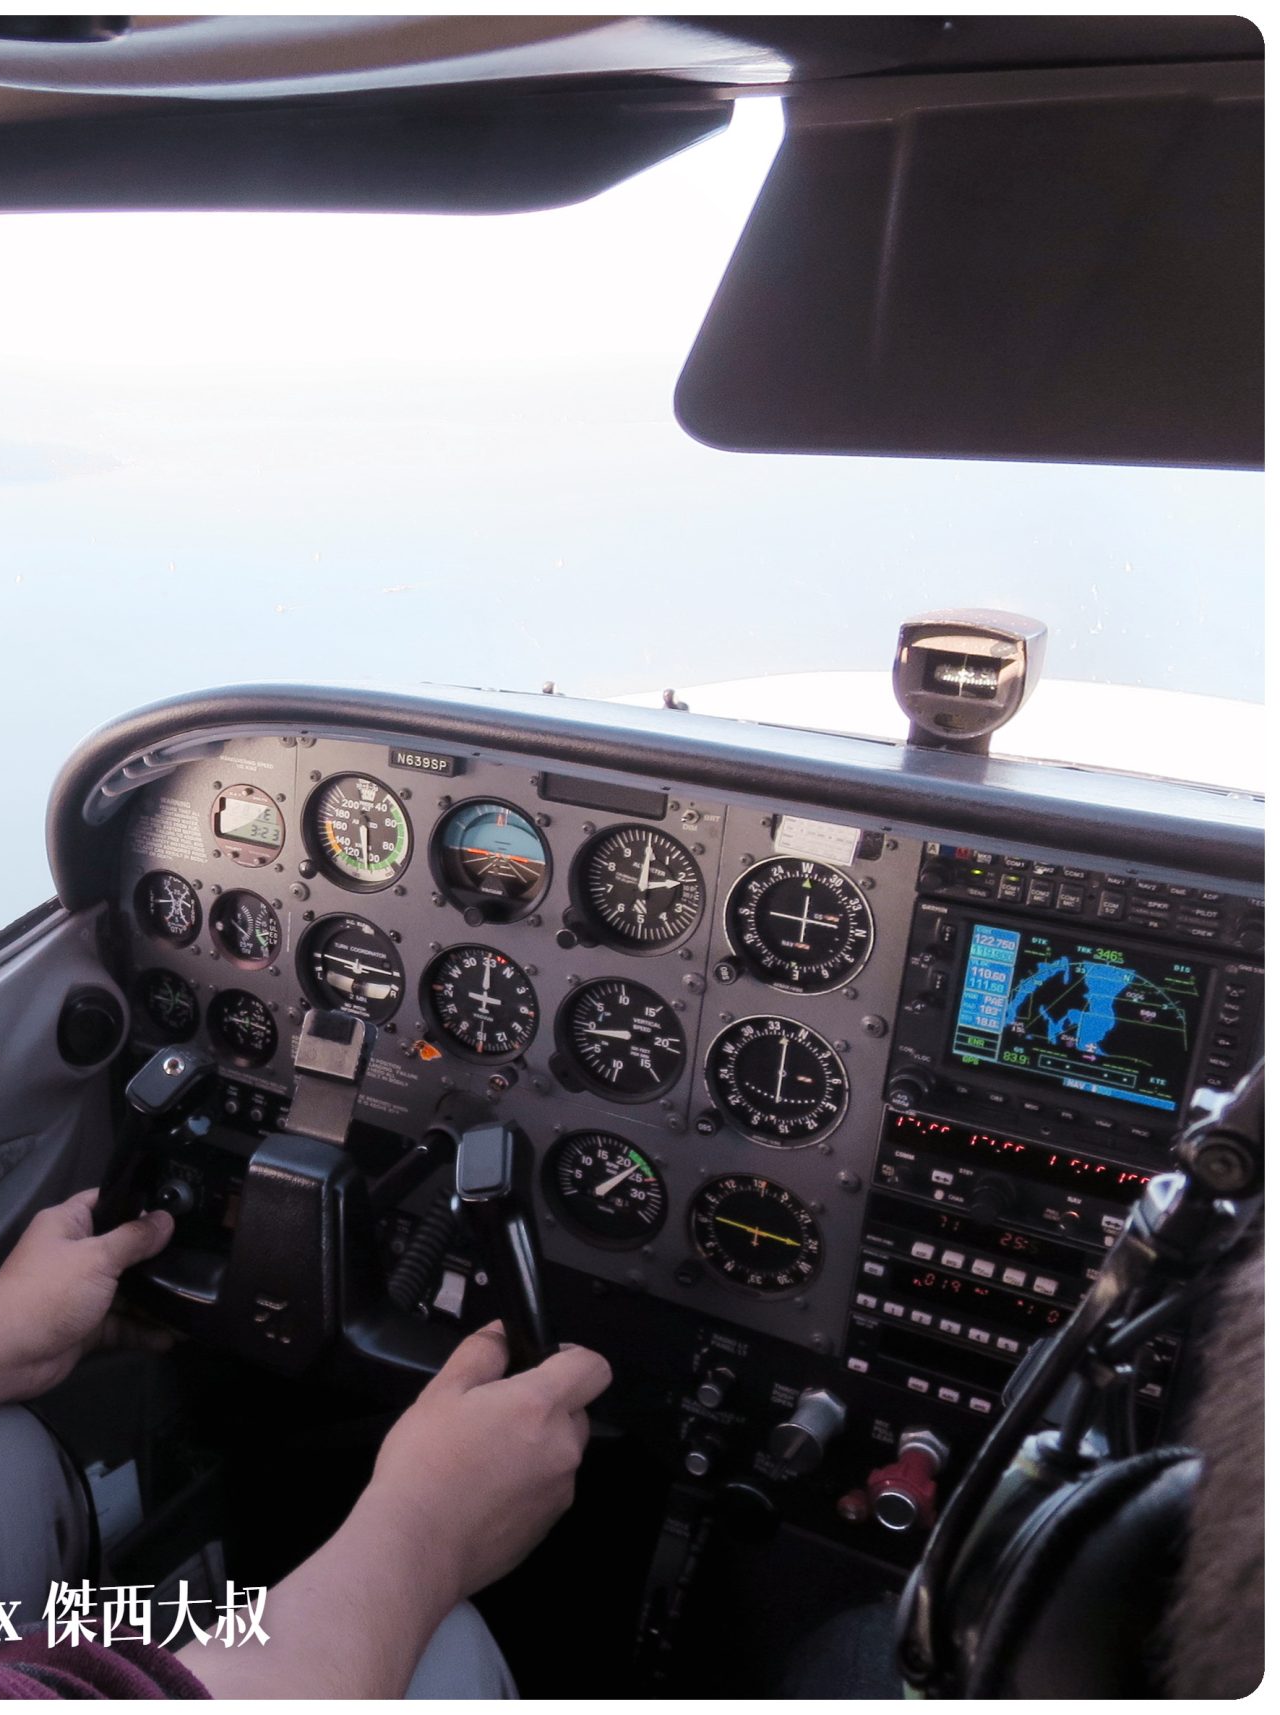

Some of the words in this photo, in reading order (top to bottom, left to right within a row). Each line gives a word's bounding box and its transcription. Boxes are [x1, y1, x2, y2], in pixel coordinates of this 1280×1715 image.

[397, 753, 447, 771] N639SP
[342, 799, 359, 810] 200
[375, 802, 387, 812] 40
[385, 818, 397, 828] 60
[383, 841, 394, 851] 80
[344, 846, 359, 857] 120
[624, 848, 632, 858] 9
[608, 862, 616, 871] 8
[771, 865, 785, 876] 24
[801, 862, 814, 874] W
[678, 872, 686, 881] 2
[829, 874, 844, 887] 30
[606, 884, 614, 893] 7
[748, 880, 761, 893] 21
[617, 903, 625, 912] 6
[675, 903, 683, 913] 3
[849, 897, 863, 912] 33
[659, 912, 667, 921] 4
[1195, 909, 1218, 918] PILOT
[637, 915, 644, 924] 5
[854, 928, 867, 938] N
[975, 934, 1015, 950] 122.750
[463, 957, 477, 968] 30
[449, 965, 462, 979] W
[502, 966, 515, 979] N
[792, 969, 799, 981] E
[390, 990, 397, 998] R
[444, 983, 454, 997] 24
[619, 996, 629, 1005] 10
[598, 1003, 604, 1012] 5
[645, 1007, 656, 1017] 15
[588, 1021, 596, 1030] 0
[633, 1018, 662, 1029] VERTICAL
[633, 1024, 652, 1032] SPEED
[768, 1021, 781, 1031] 33
[741, 1025, 755, 1037] 30
[798, 1028, 809, 1040] N
[496, 1032, 507, 1042] 12
[654, 1037, 669, 1048] 20
[722, 1041, 736, 1054] W
[594, 1044, 601, 1053] 5
[613, 1059, 623, 1070] 10
[640, 1059, 651, 1068] 15
[597, 1149, 609, 1160] 15
[582, 1155, 593, 1166] 10
[617, 1155, 631, 1167] 20
[575, 1169, 583, 1179] 5
[630, 1188, 646, 1200] 30
